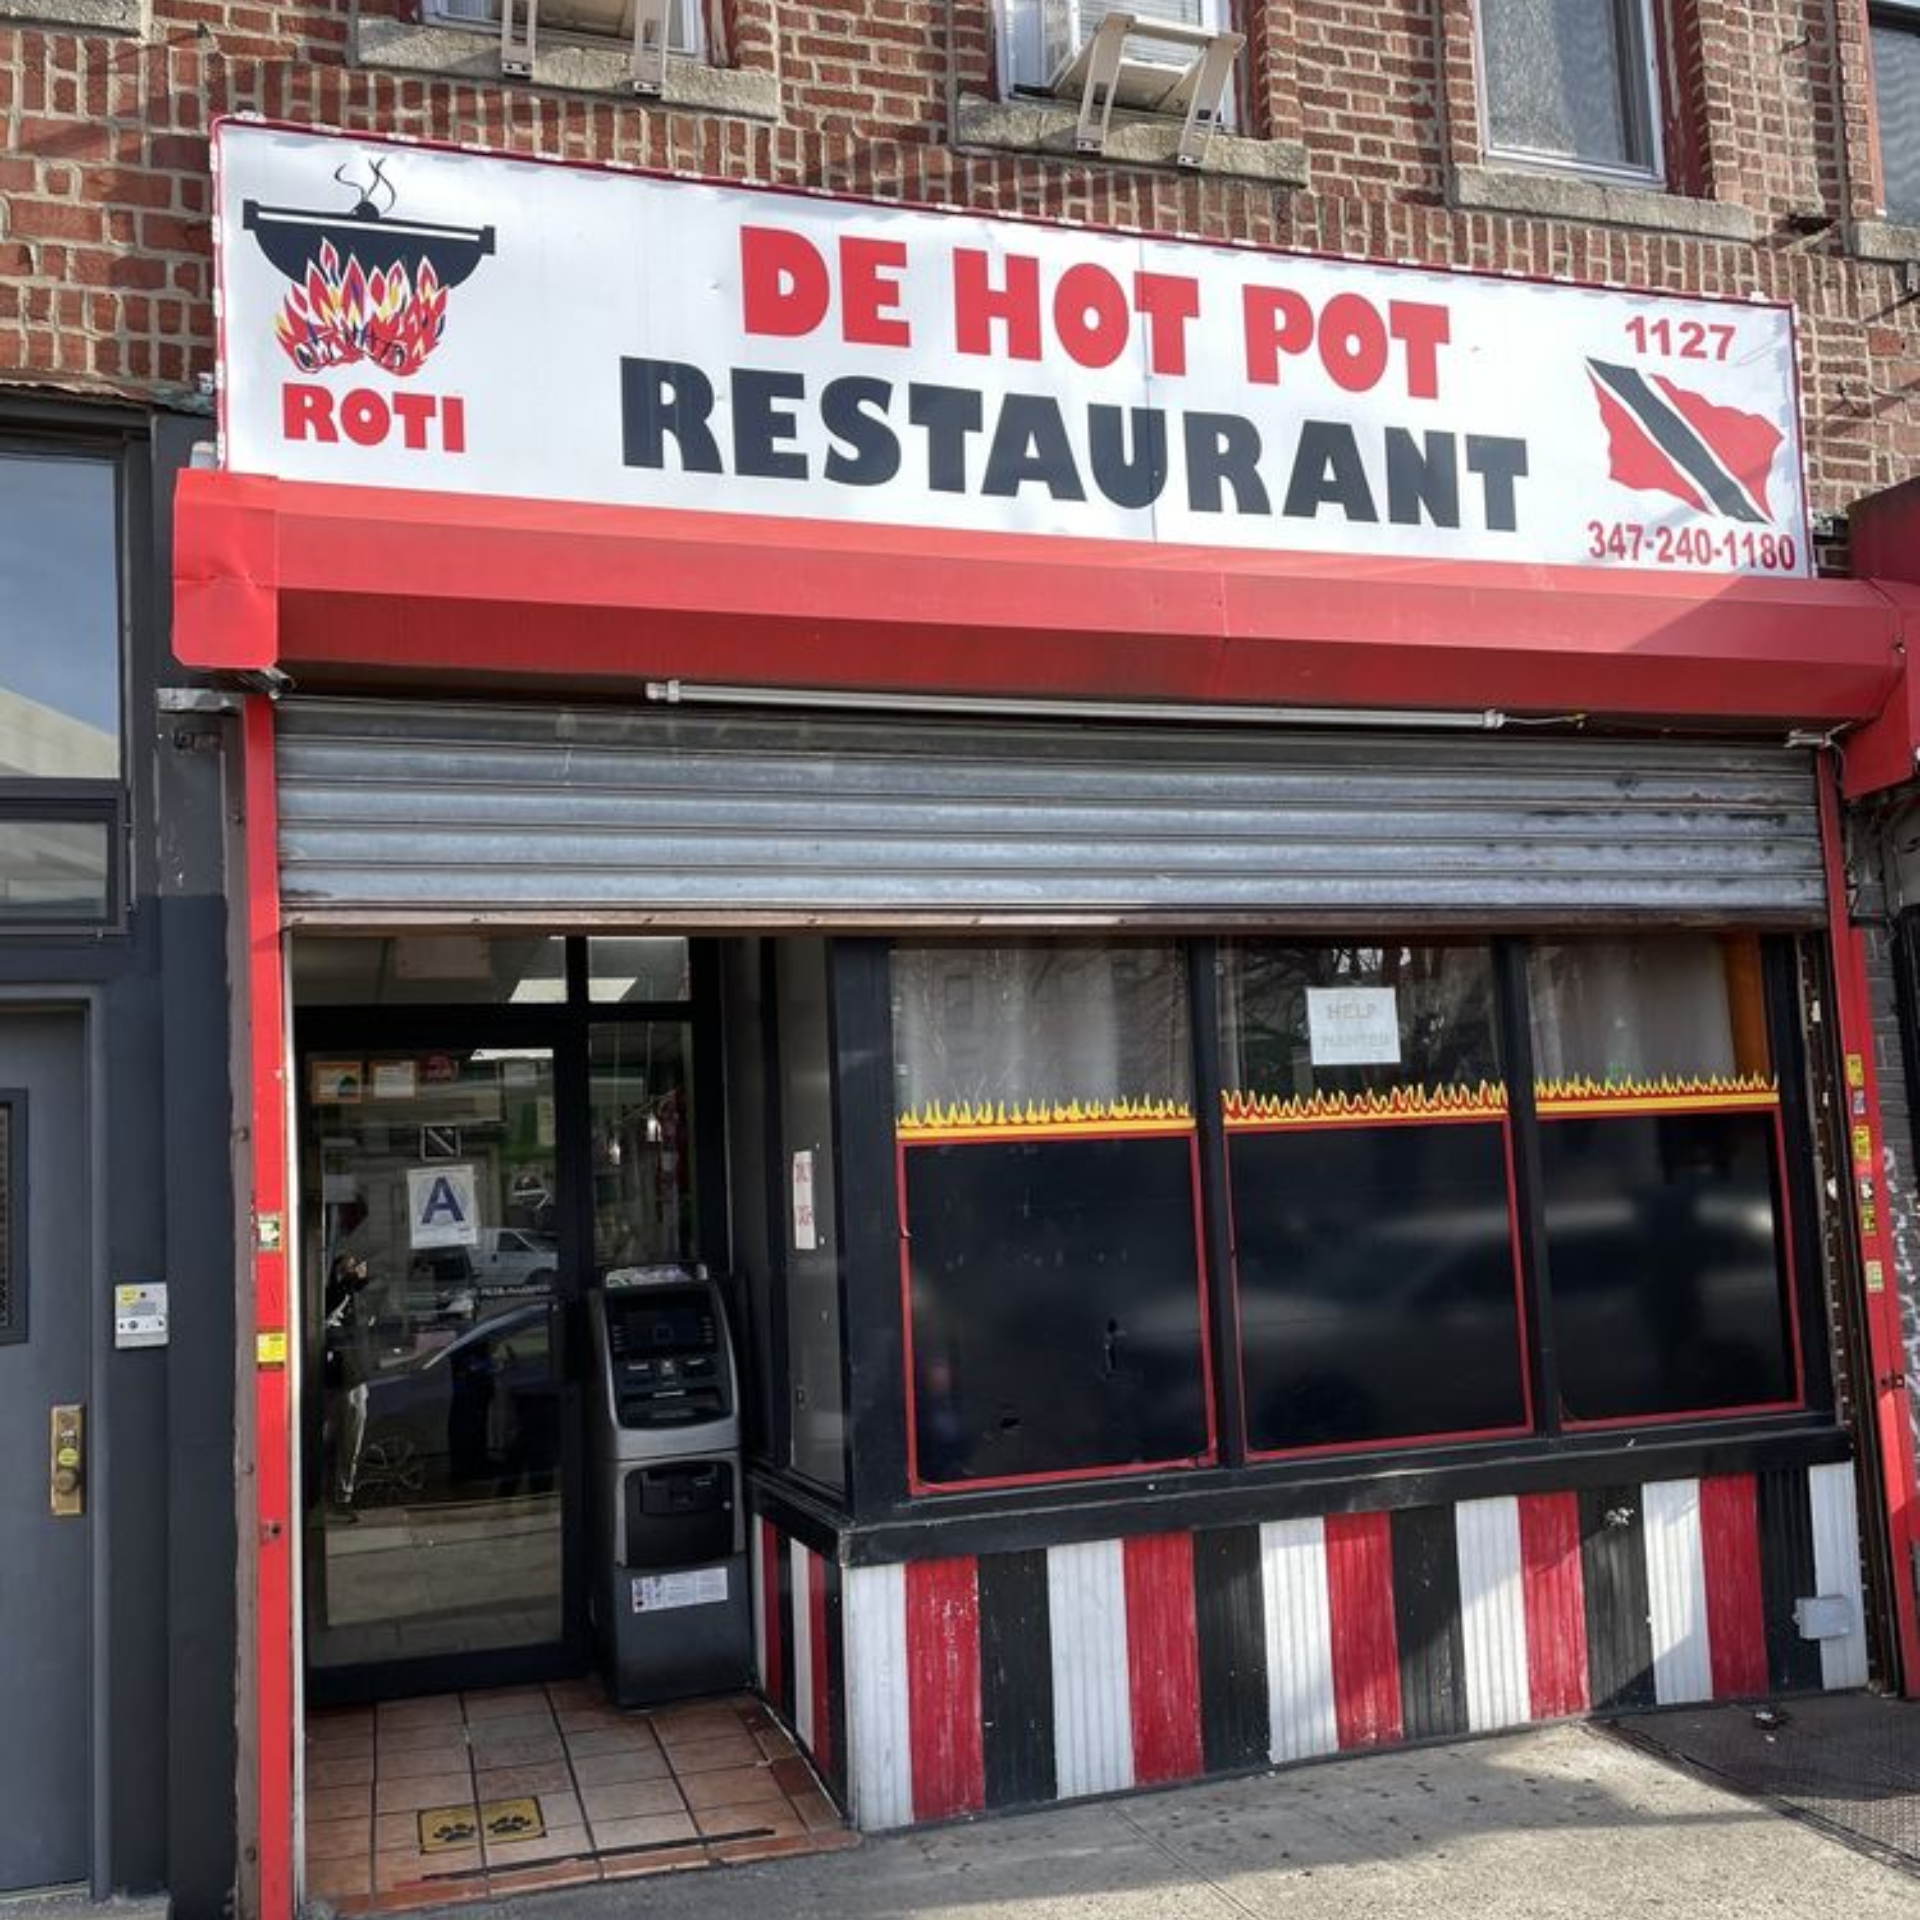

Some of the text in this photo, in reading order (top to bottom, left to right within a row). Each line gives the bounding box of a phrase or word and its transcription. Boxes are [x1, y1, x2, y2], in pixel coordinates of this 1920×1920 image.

[740, 226, 1450, 399] DE HOT POT
[1625, 315, 1738, 361] 1127
[282, 383, 466, 453] ROTI
[620, 356, 1529, 532] RESTAURANT
[1587, 521, 1796, 572] 347-240-1180
[422, 1177, 465, 1224] A
